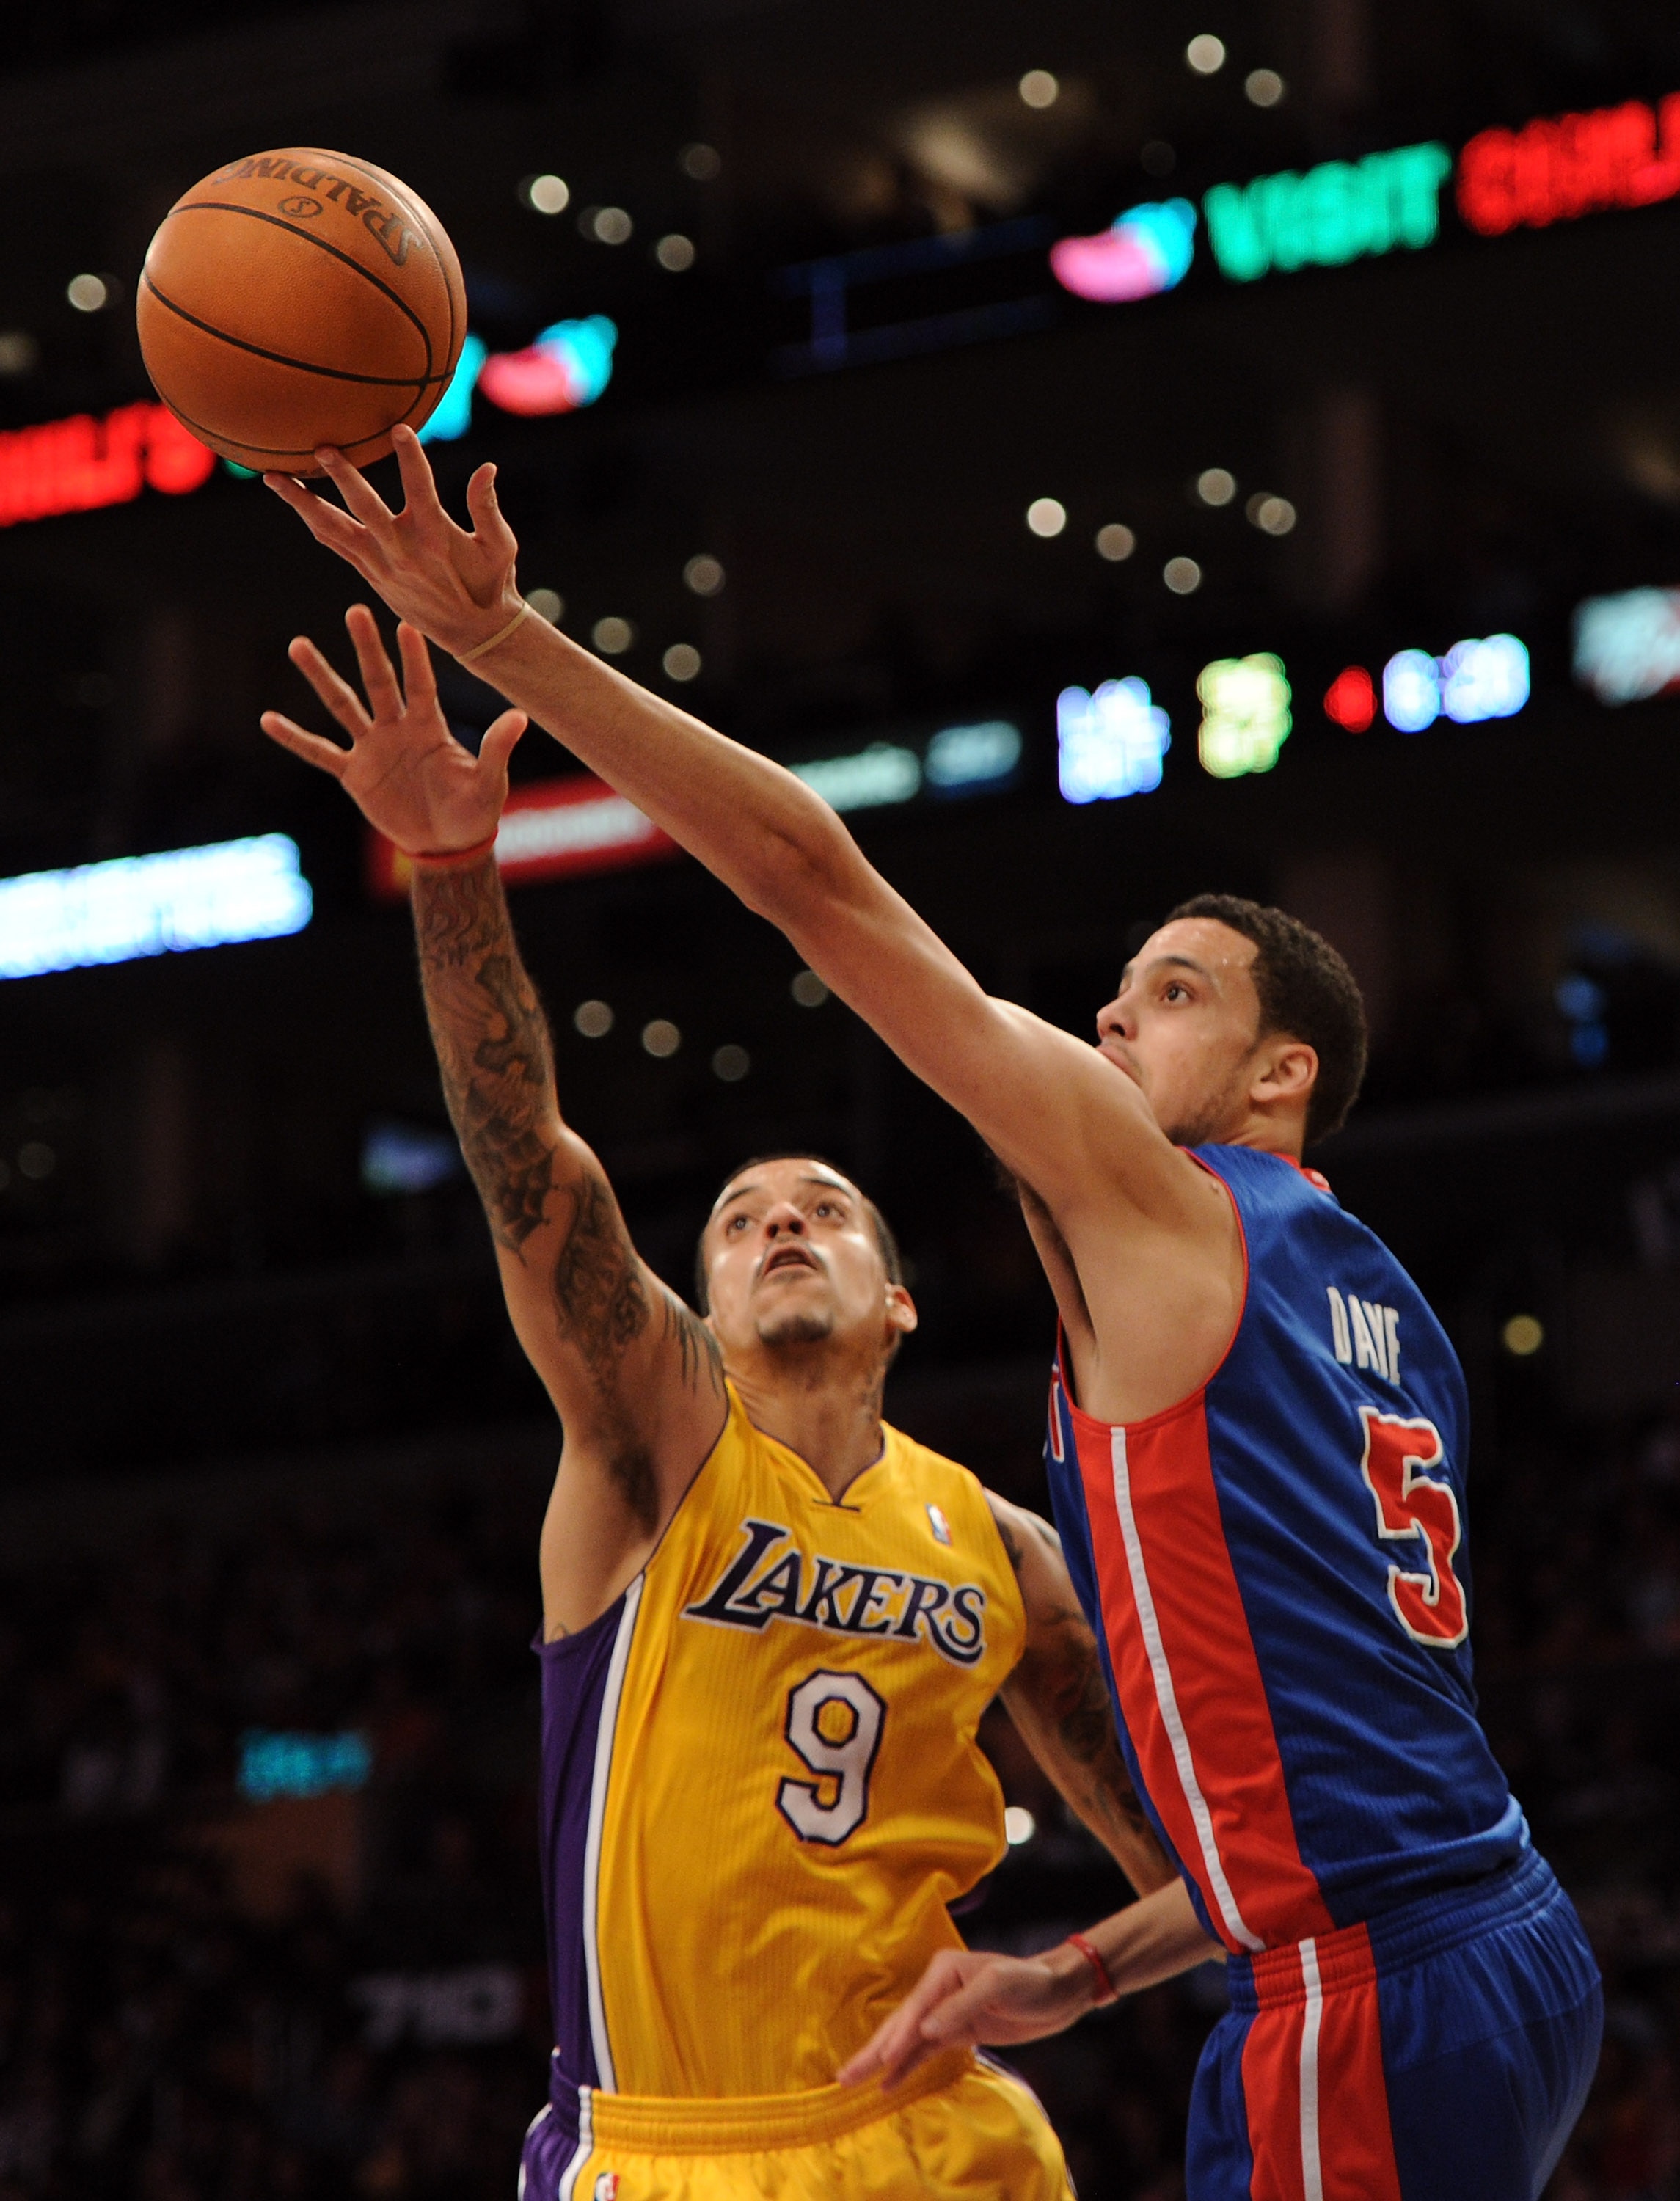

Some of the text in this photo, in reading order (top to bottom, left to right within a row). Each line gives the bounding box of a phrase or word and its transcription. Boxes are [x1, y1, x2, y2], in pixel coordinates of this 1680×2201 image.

[211, 156, 424, 267] SPALDING
[680, 1517, 987, 1668] LAKERS
[1358, 1406, 1468, 1649] 5
[775, 1668, 888, 1848] 9
